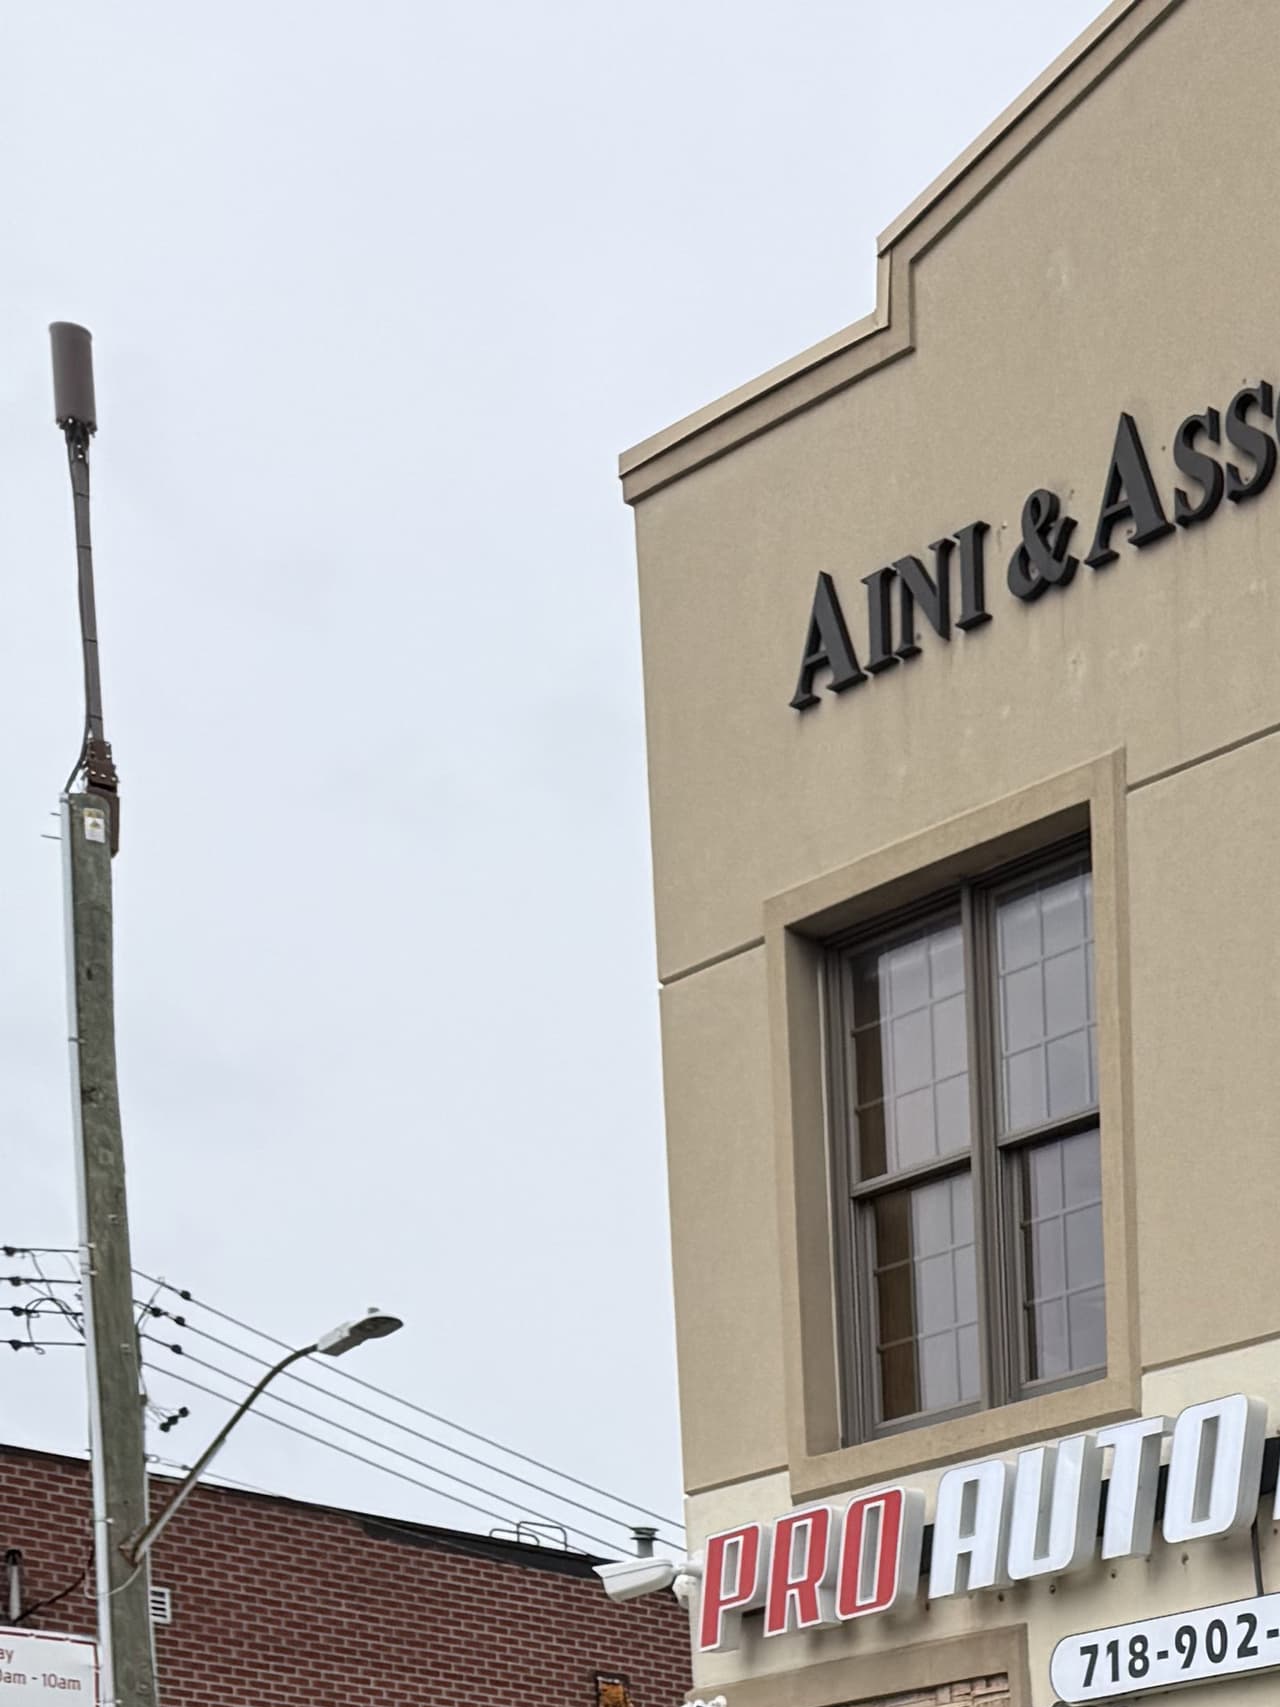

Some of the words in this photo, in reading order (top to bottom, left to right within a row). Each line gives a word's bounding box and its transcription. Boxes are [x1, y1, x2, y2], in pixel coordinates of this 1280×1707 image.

[789, 521, 993, 712] AINI
[1007, 488, 1078, 600] &
[699, 1486, 923, 1652] PRO
[929, 1393, 1265, 1601] AUTO
[42, 1673, 81, 1691] 10am
